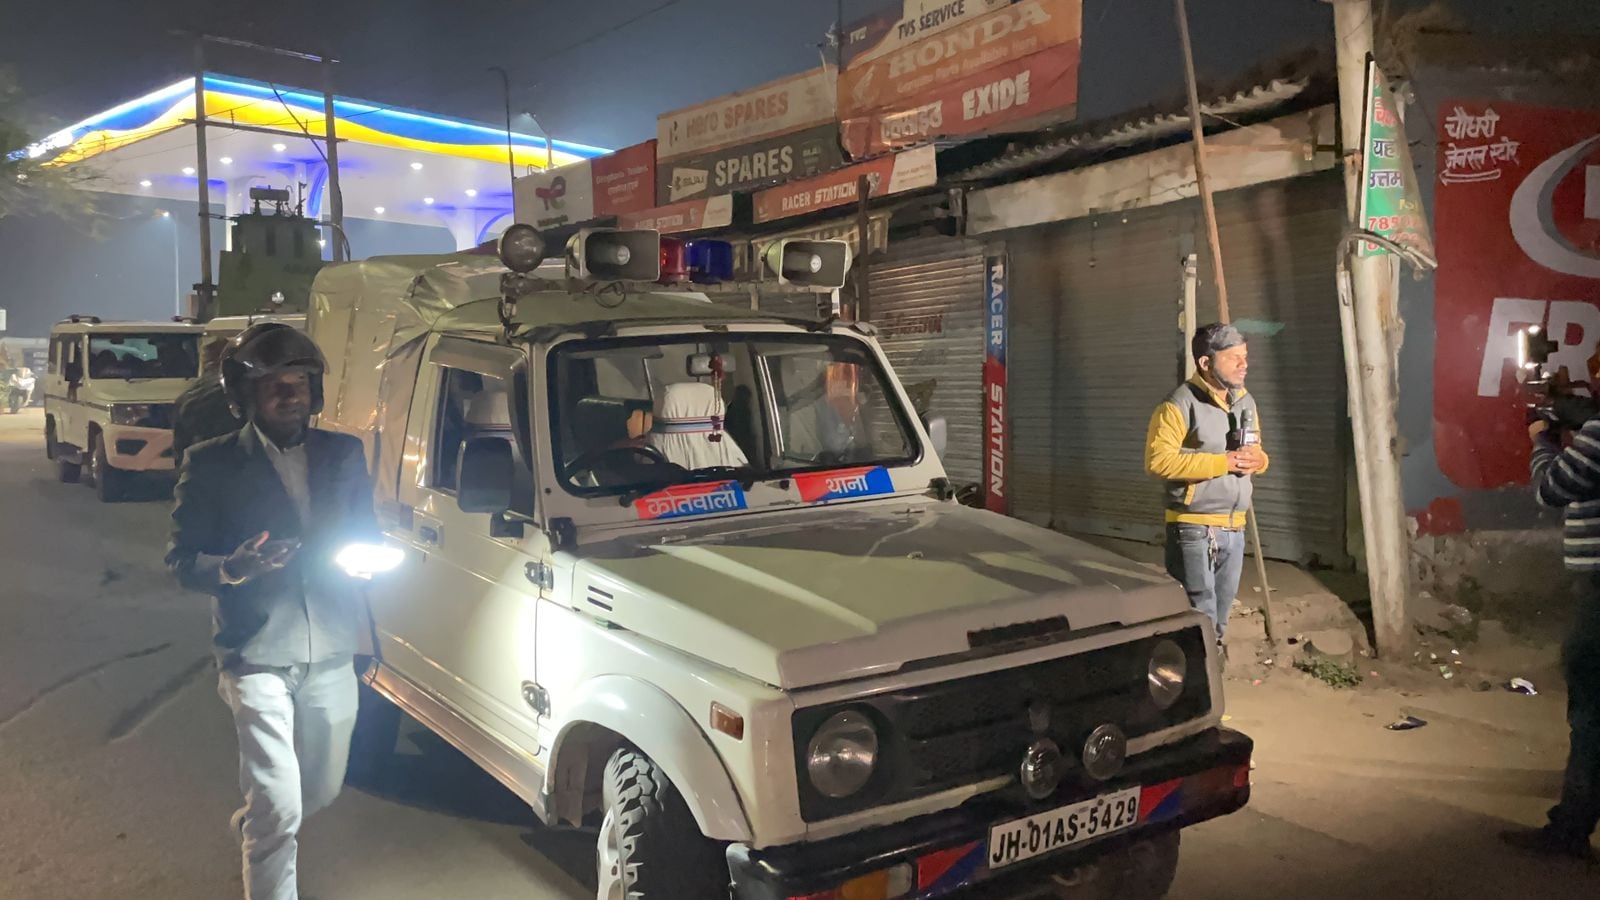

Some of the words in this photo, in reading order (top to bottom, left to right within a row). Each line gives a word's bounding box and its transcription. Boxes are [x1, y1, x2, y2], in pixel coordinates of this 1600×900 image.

[888, 1, 1052, 79] HONDA
[898, 20, 916, 39] TVS
[919, 0, 965, 31] SERVICE
[724, 91, 789, 129] SPARES
[962, 70, 1031, 120] EXIDE
[715, 145, 793, 187] SPARES
[781, 191, 811, 212] RACER
[814, 180, 858, 204] STATION
[990, 262, 1004, 346] RACER
[990, 382, 1005, 497] STATION
[825, 475, 869, 494] थाना
[992, 797, 1137, 863] JH-01AS-5429
